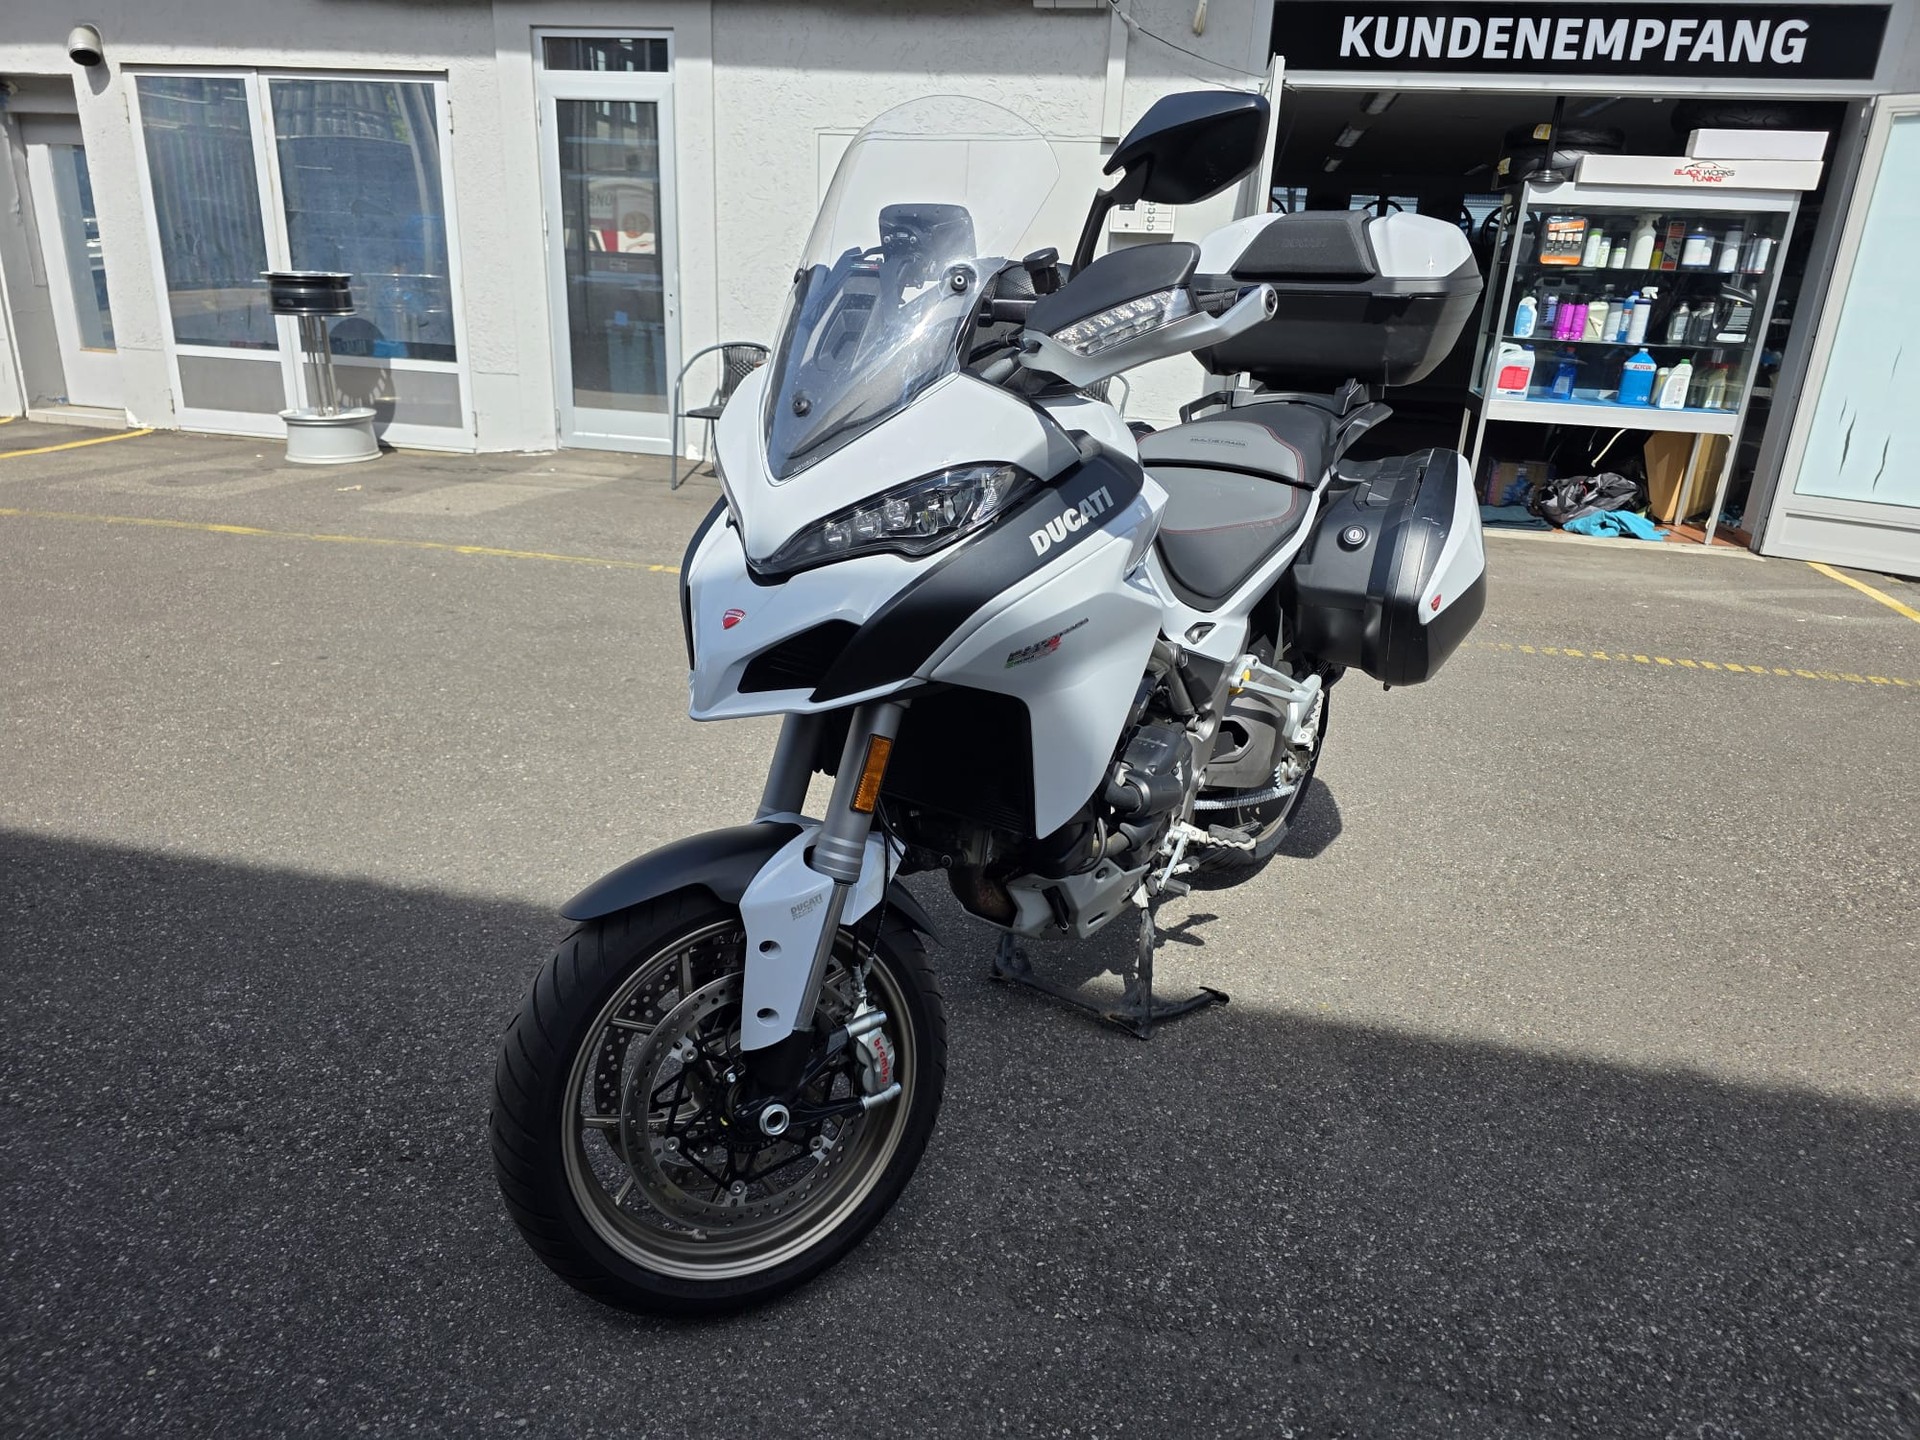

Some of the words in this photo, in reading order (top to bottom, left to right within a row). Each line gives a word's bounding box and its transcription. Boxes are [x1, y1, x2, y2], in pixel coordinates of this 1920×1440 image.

[1340, 16, 1809, 64] KUNDENEMPFANG
[1674, 169, 1703, 177] BLACK
[1703, 169, 1736, 177] WORKS
[1029, 485, 1114, 557] DUCATI
[791, 894, 823, 914] DUCATI
